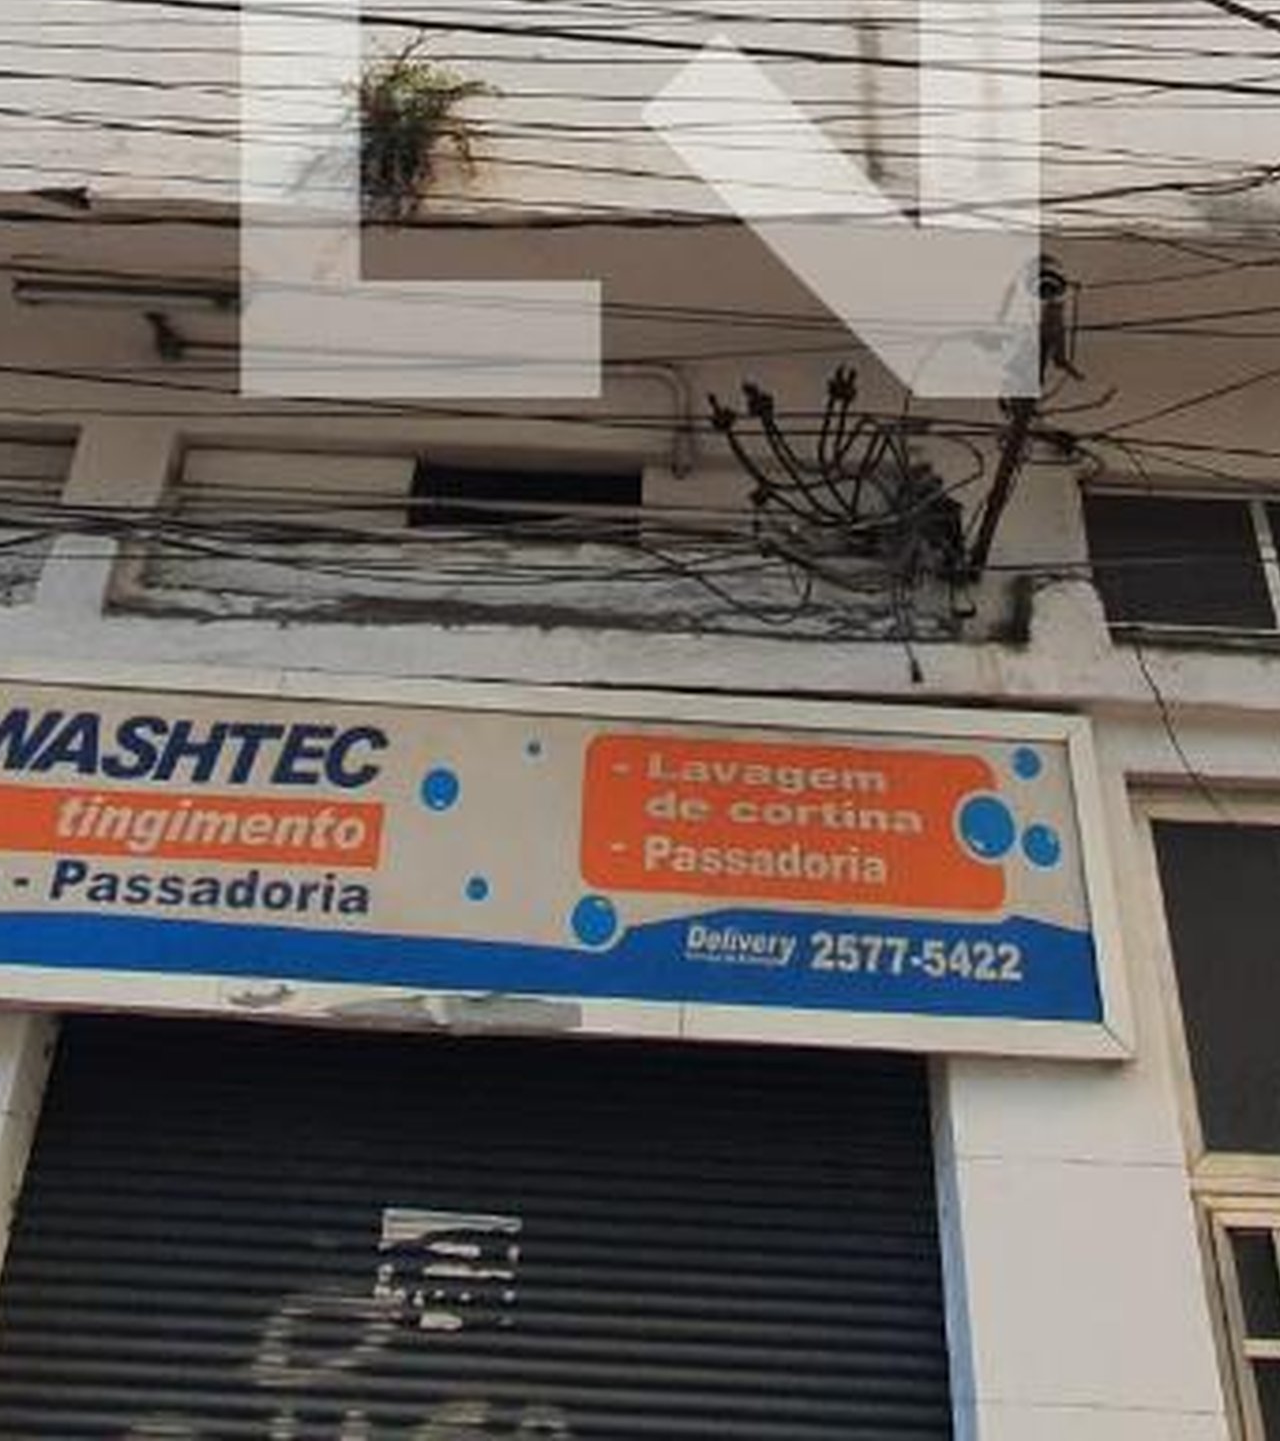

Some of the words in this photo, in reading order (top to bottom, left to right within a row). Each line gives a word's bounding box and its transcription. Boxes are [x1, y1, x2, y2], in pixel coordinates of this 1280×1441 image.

[648, 754, 888, 794] Lavagem
[55, 796, 367, 852] tingimento
[644, 791, 711, 823] de
[729, 798, 924, 834] cortina
[49, 857, 371, 915] Passadoria
[644, 836, 888, 886] Passadoria
[687, 924, 796, 965] Delivery
[808, 930, 1023, 982] 2577-5422
